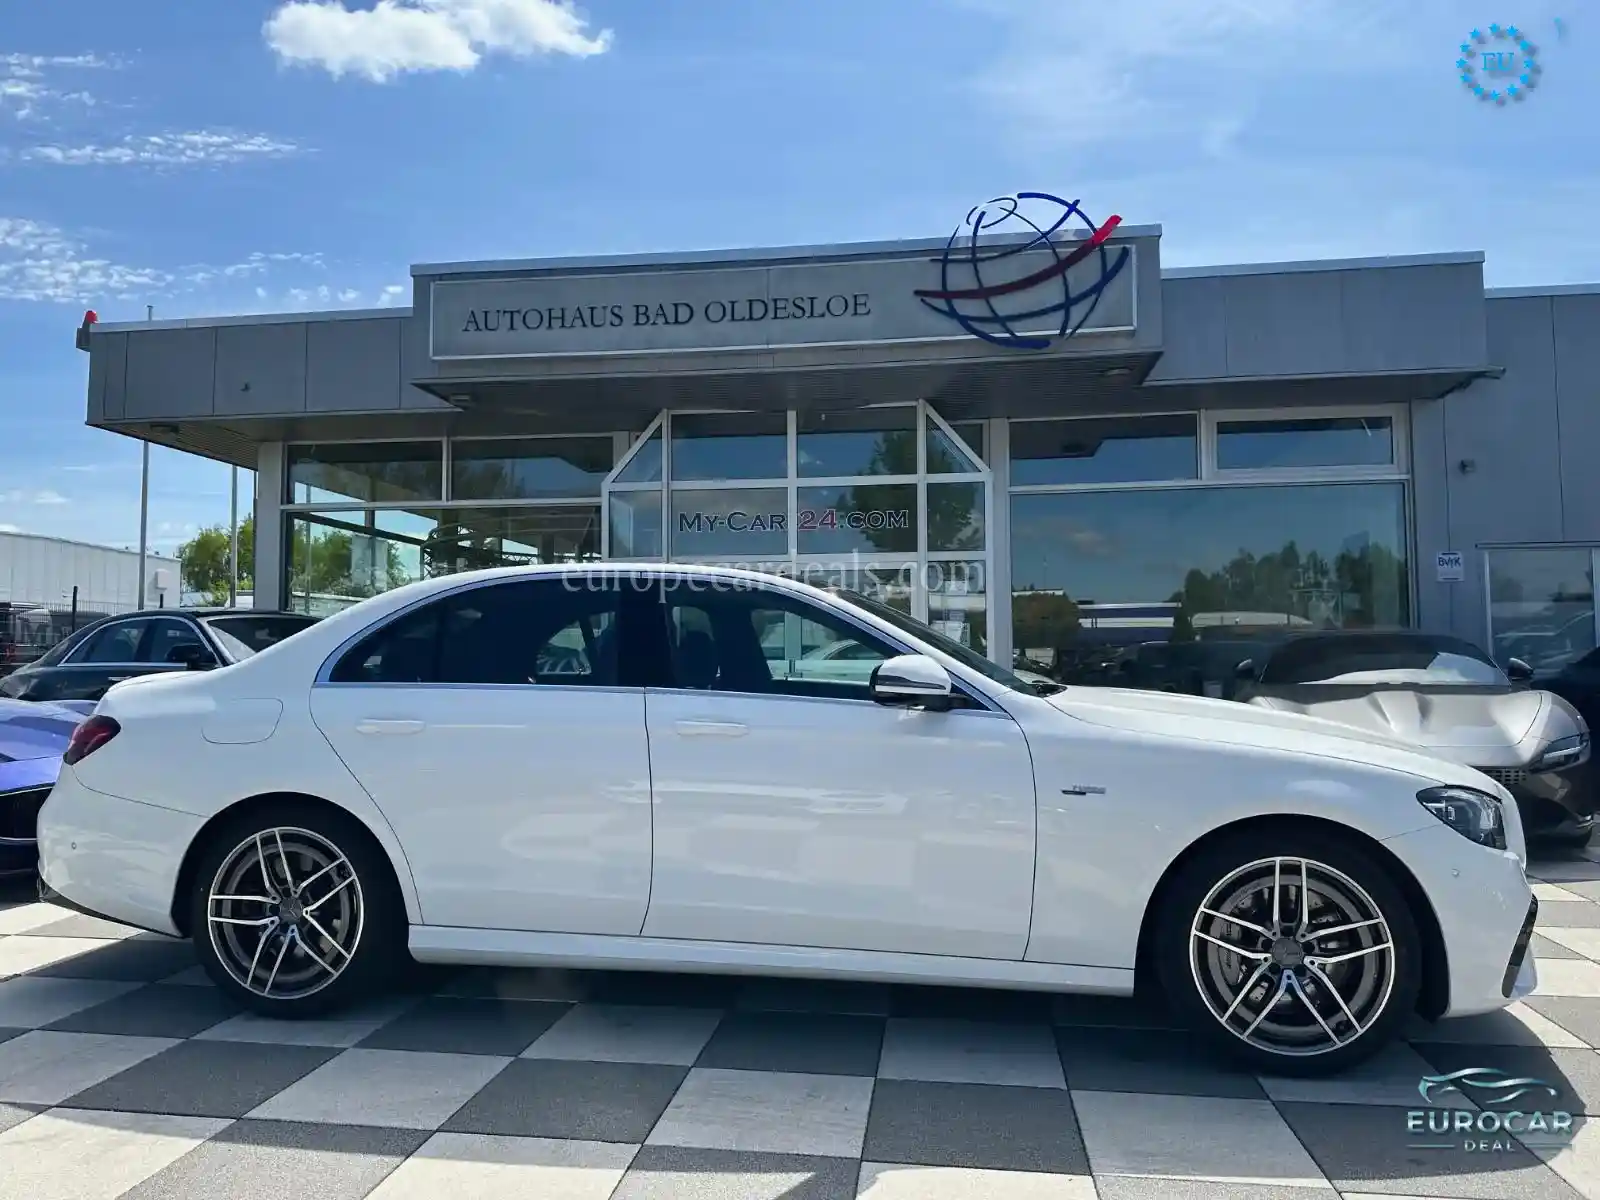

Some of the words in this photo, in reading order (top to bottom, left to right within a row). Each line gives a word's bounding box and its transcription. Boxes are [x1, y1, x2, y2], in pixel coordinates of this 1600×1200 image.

[461, 304, 624, 333] AUTOHAUS
[632, 302, 694, 327] BAD
[704, 293, 871, 323] OLDESLOE
